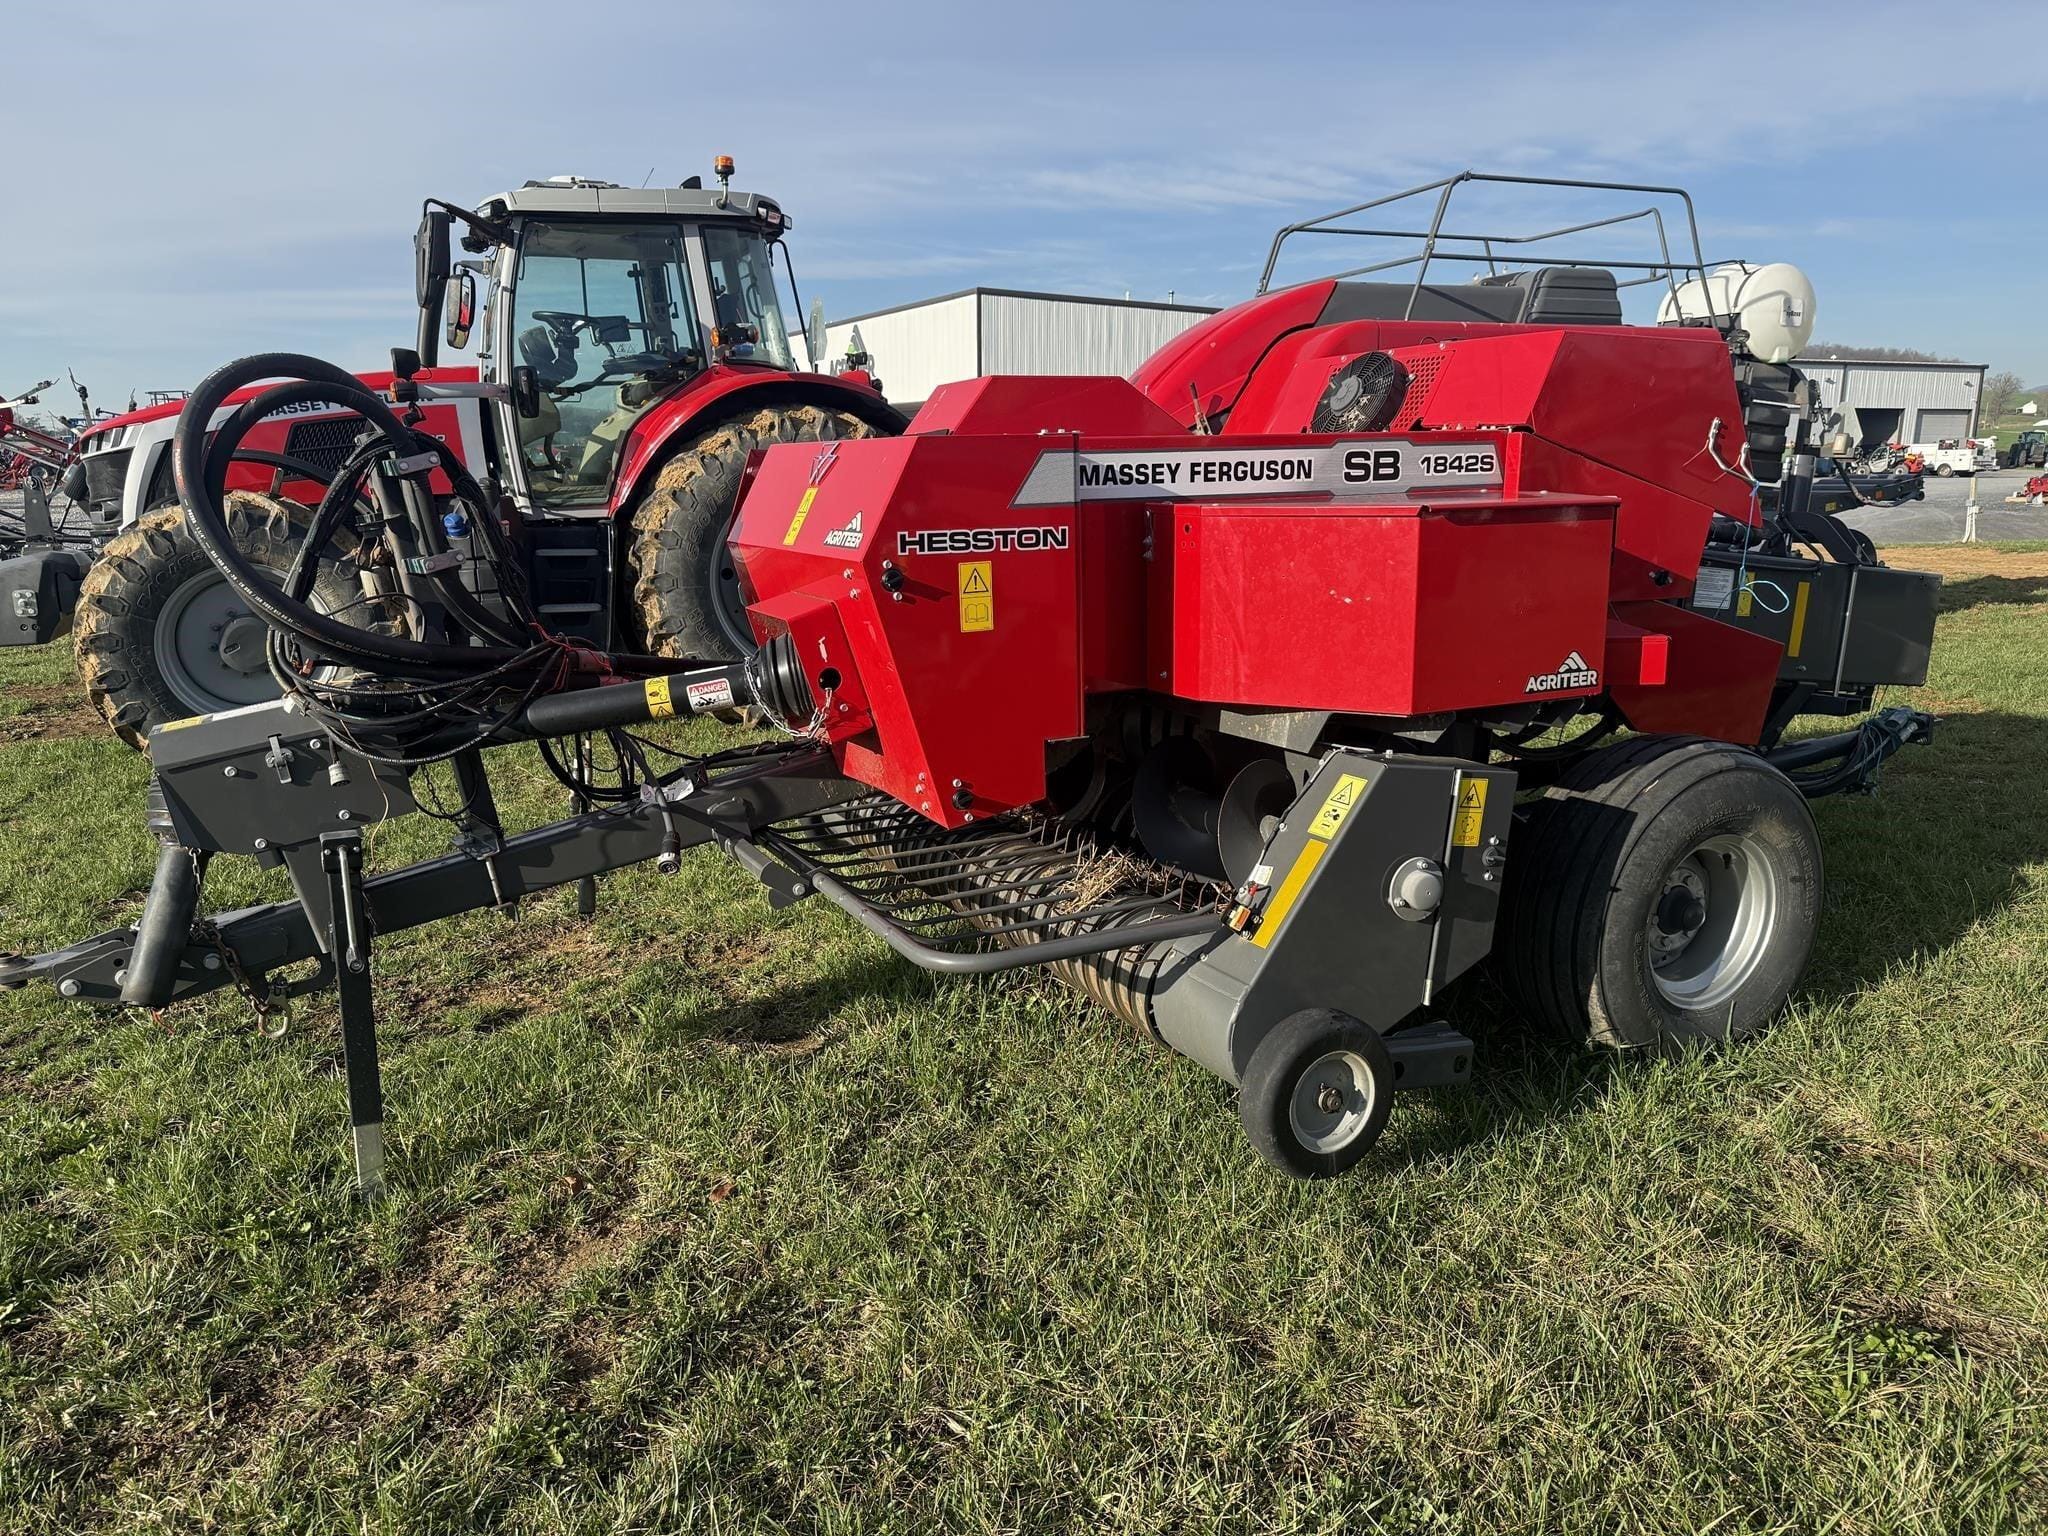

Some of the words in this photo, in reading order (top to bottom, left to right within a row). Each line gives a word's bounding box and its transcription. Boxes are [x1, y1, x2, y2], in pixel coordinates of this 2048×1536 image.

[1080, 462, 1181, 486] MASSEY
[1190, 459, 1312, 483] FERGUSON
[1343, 450, 1401, 483] SB
[1420, 455, 1495, 475] 1842S
[823, 530, 864, 548] AGRITEER
[898, 526, 1068, 554] HESSTON
[698, 682, 728, 695] DANGER
[1525, 670, 1597, 692] AGRITEER
